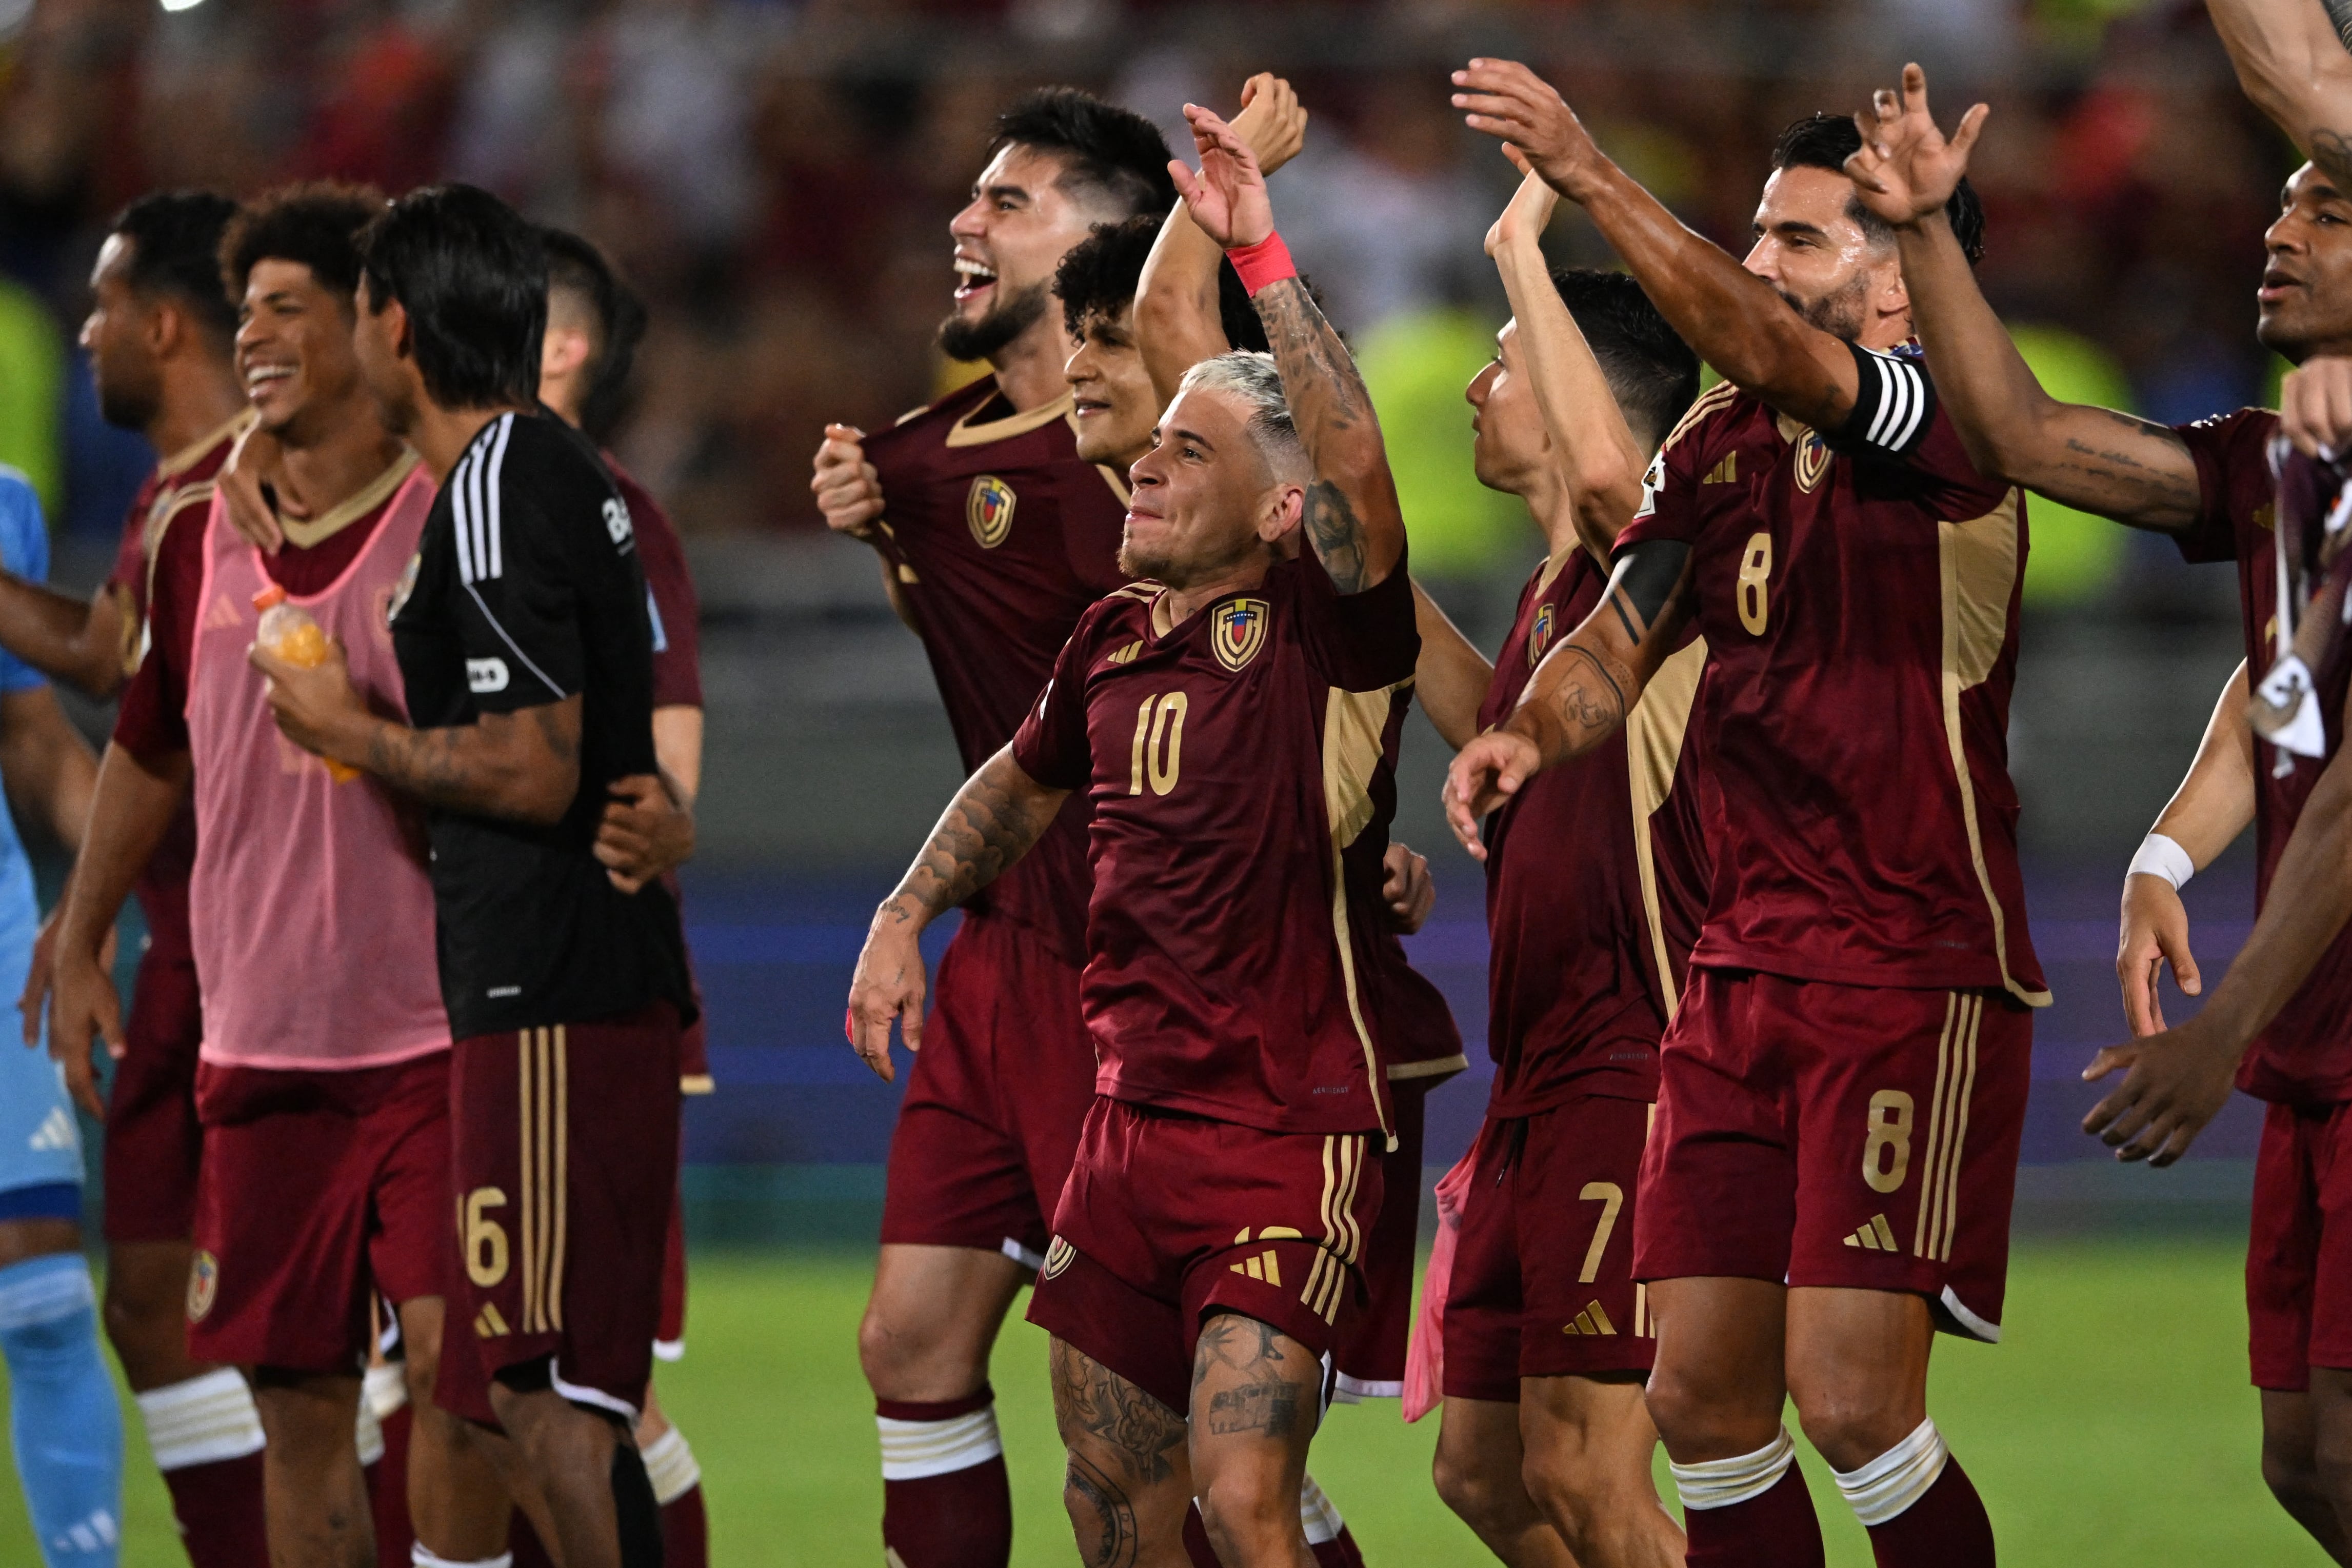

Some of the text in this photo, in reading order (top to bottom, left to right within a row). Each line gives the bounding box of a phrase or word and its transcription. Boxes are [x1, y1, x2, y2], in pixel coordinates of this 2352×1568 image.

[1737, 533, 1772, 636] 8
[1129, 691, 1188, 796] 10
[1313, 1087, 1349, 1095] AEREADY
[1862, 1089, 1914, 1193] 8
[1578, 1182, 1623, 1283] 7
